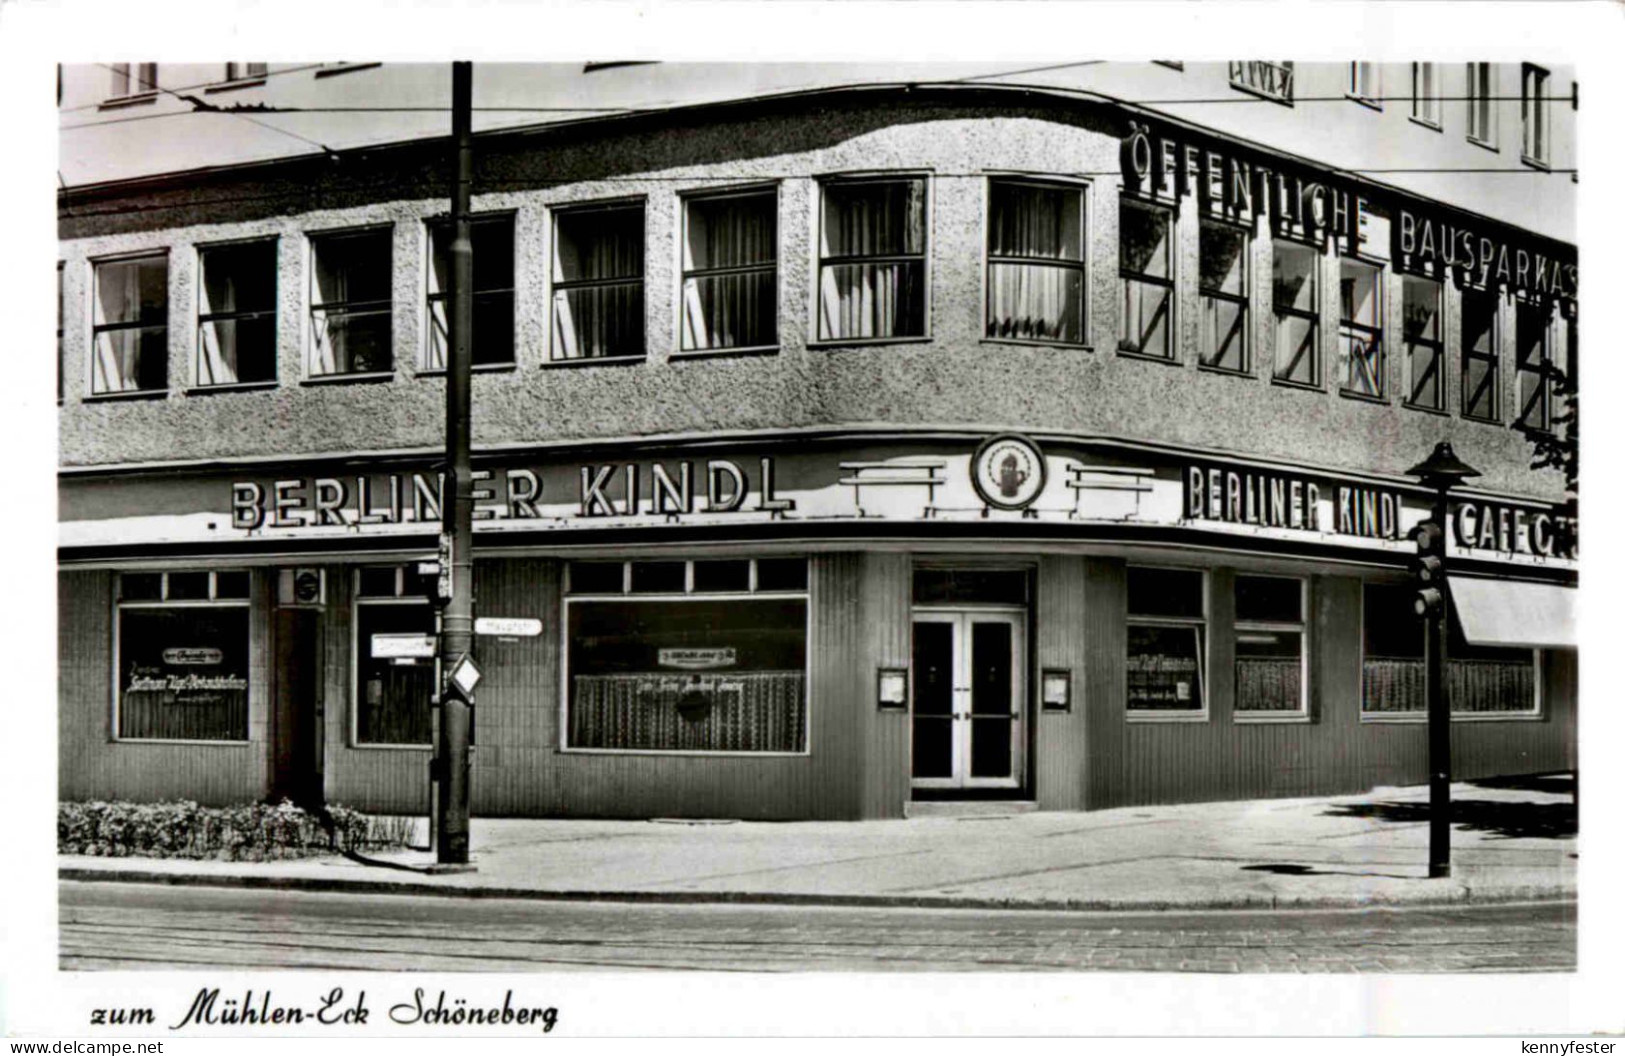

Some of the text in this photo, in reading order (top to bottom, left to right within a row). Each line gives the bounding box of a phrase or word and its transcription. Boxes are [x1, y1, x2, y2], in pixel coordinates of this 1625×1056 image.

[1126, 120, 1370, 247] ÖFFENTLICHE
[232, 457, 794, 530] BERLINER KINDL
[1187, 466, 1322, 530] BERLINER
[1338, 486, 1412, 539] KINDL
